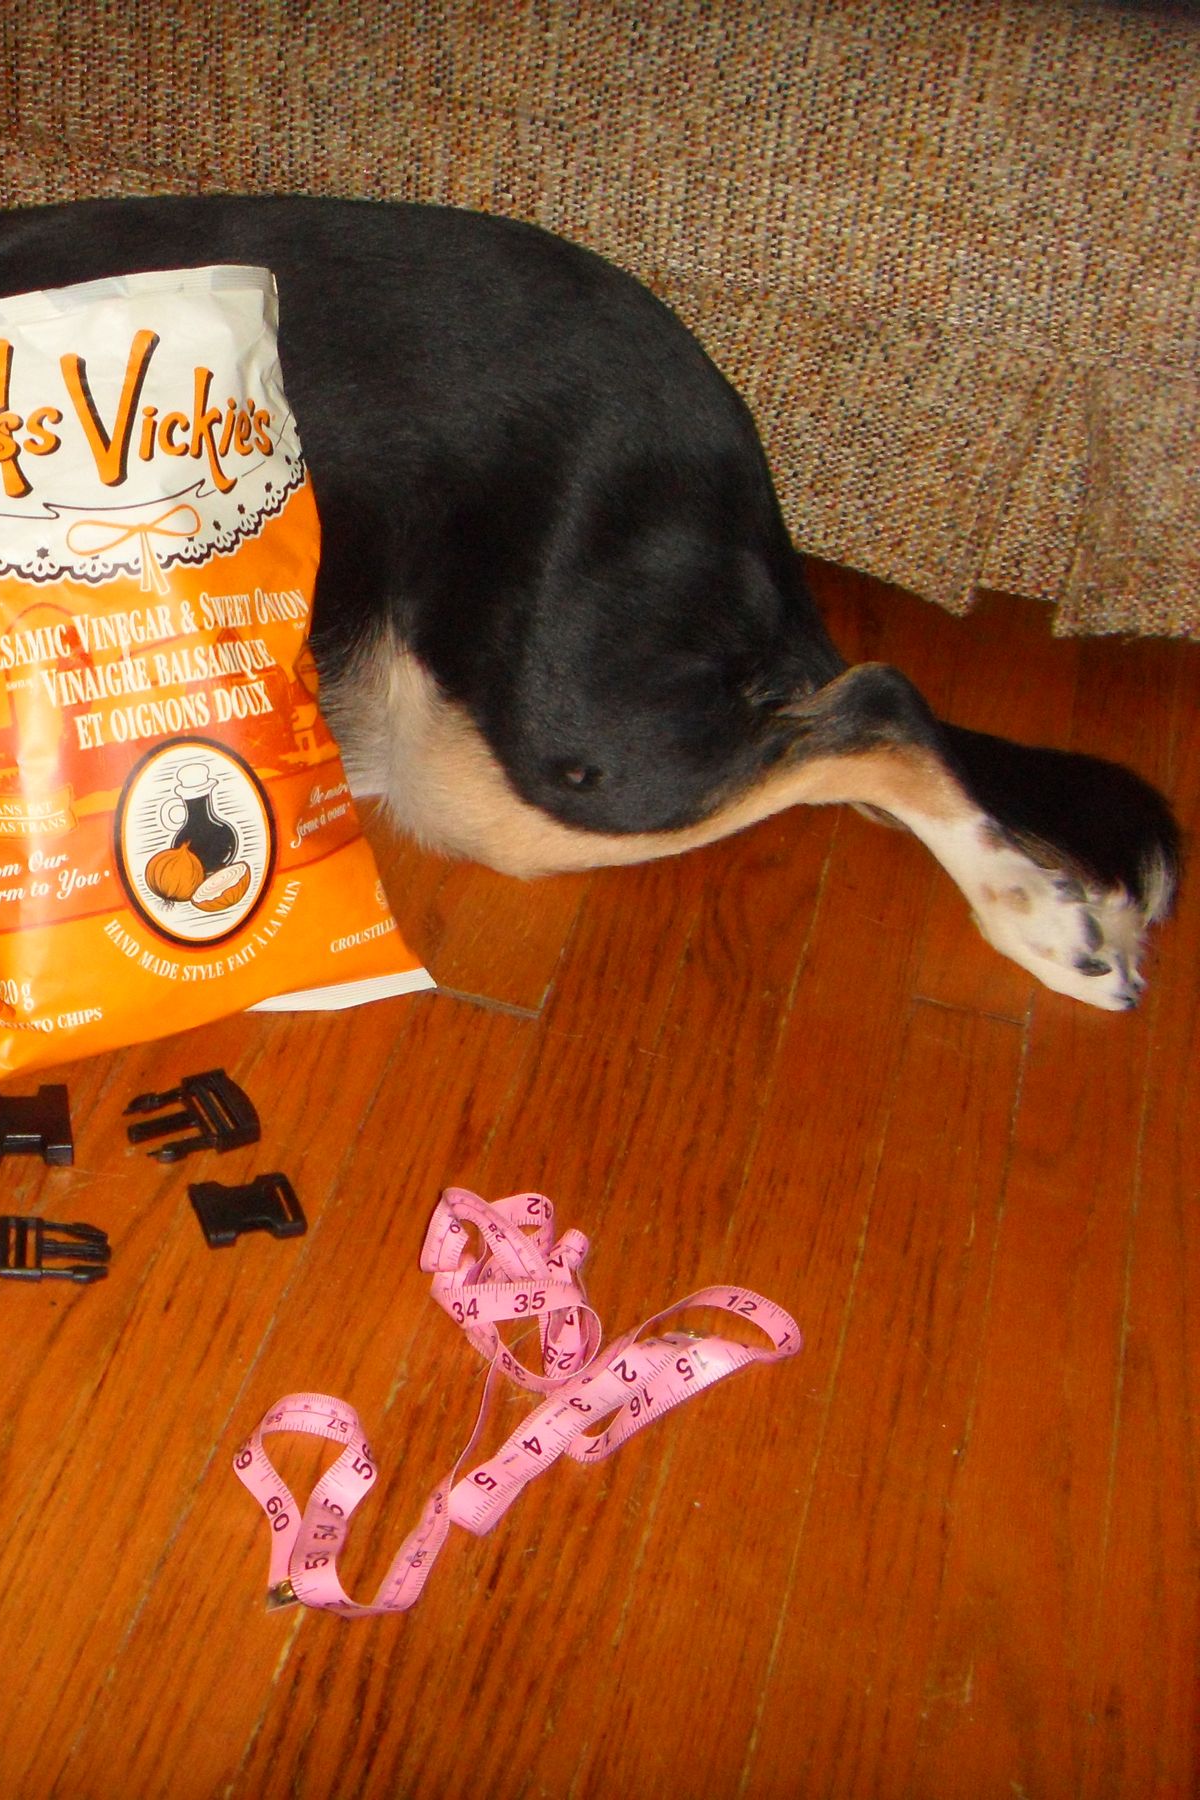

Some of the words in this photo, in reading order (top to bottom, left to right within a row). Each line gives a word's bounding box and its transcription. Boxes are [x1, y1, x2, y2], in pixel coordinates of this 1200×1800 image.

[72, 605, 176, 653] VINEGAR
[181, 600, 198, 634] &
[199, 592, 252, 630] SWEET
[255, 588, 309, 624] ONION
[40, 656, 151, 707] VINAIGRE
[153, 639, 275, 686] BALSAMIQUE
[74, 713, 104, 751] ET
[111, 696, 210, 743] OIGNONS
[214, 680, 274, 723] DOUX
[27, 802, 52, 816] FAT
[19, 816, 66, 833] TRANS
[28, 851, 69, 872] Our
[30, 881, 49, 897] to
[57, 869, 101, 900] You
[103, 919, 140, 958] HAND
[139, 951, 178, 980] MADE
[181, 961, 225, 981] STYLE
[227, 943, 256, 972] FAIT
[254, 934, 268, 949] À
[263, 919, 282, 938] LA
[276, 880, 302, 917] MAIN
[21, 982, 34, 1011] g
[57, 1007, 102, 1029] CHIPS
[452, 1298, 479, 1324] 34
[513, 1291, 546, 1313] 35
[727, 1295, 758, 1317] 12
[544, 1346, 576, 1370] 25
[675, 1349, 709, 1382] 15
[613, 1359, 637, 1383] 2
[569, 1397, 592, 1412] 3
[630, 1388, 654, 1418] 16
[327, 1418, 349, 1433] 57
[522, 1436, 543, 1456] 4
[474, 1471, 497, 1491] 5
[266, 1495, 290, 1532] 60
[313, 1523, 338, 1541] 54
